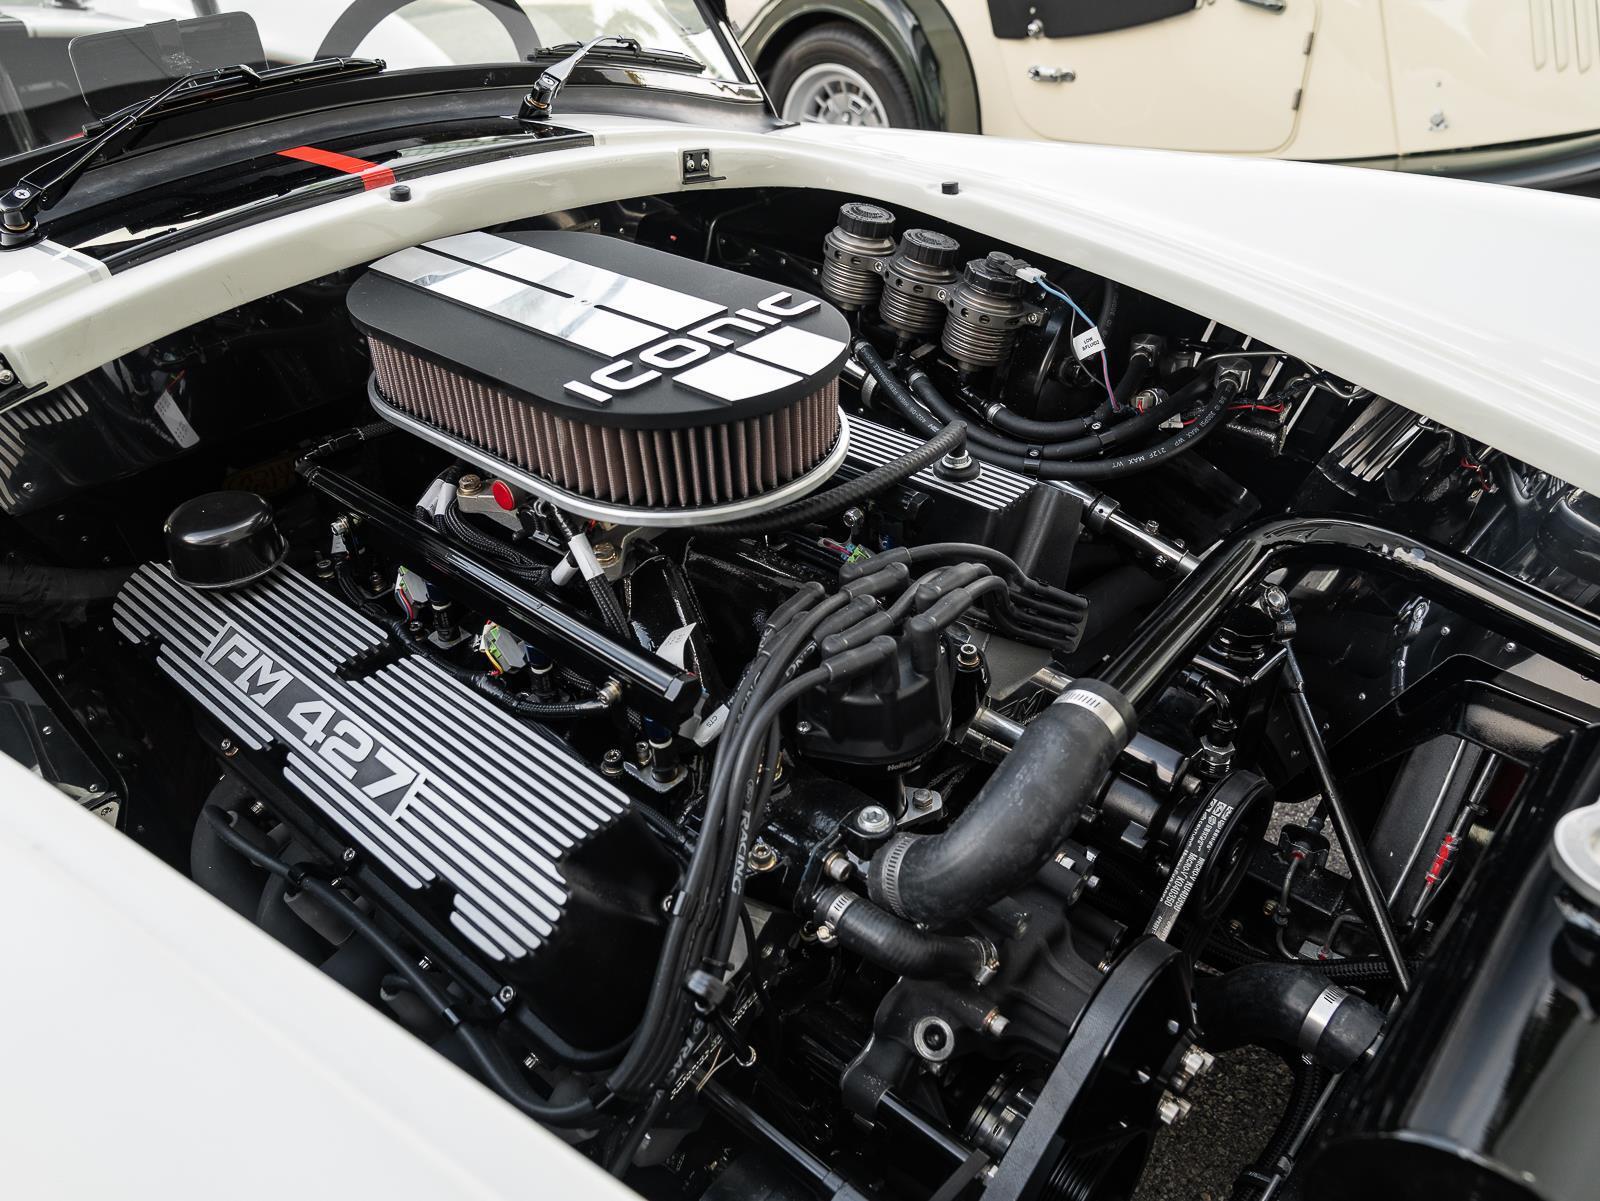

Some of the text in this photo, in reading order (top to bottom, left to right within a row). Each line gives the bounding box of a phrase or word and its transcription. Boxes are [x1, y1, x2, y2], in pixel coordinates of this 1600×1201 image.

[1083, 337, 1094, 345] LOW
[1186, 427, 1200, 439] MAX
[1174, 437, 1185, 447] WP
[1149, 447, 1167, 459] 212F
[1112, 460, 1124, 469] WT
[1128, 455, 1145, 465] MAX
[205, 633, 420, 799] PM 427
[706, 715, 718, 728] CTS
[731, 808, 752, 895] RACING
[1164, 875, 1186, 907] K040350
